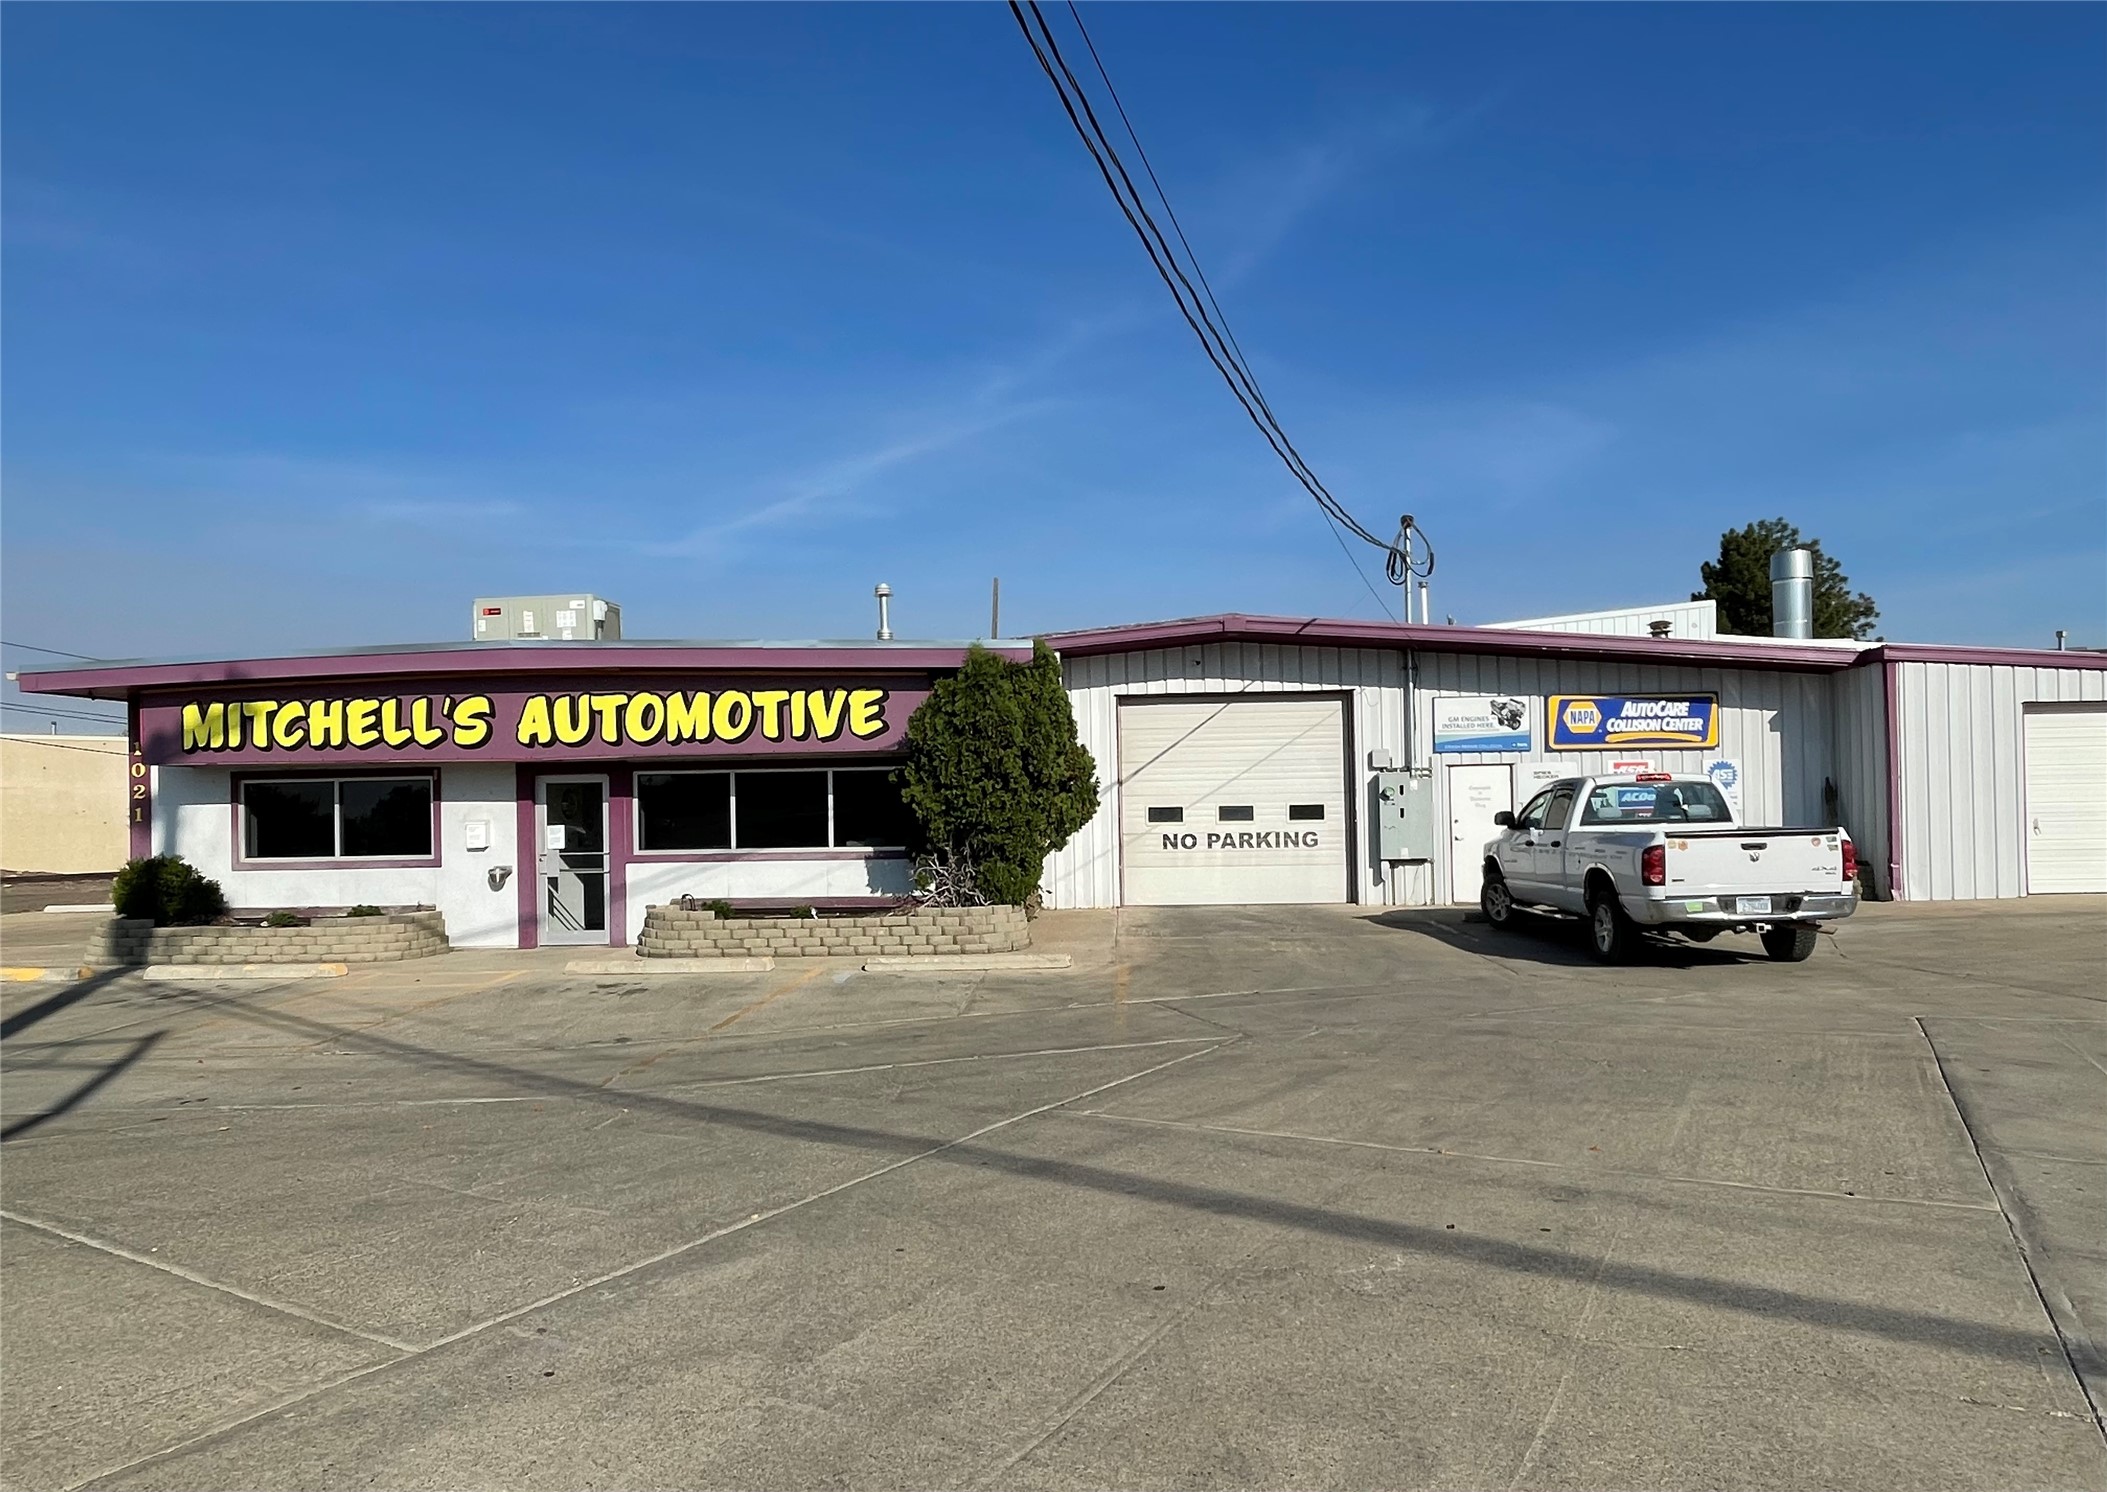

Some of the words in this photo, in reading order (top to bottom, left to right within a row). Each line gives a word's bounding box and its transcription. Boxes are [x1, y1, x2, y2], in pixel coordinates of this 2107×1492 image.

[181, 694, 495, 754] MITCHELL'S
[516, 685, 890, 748] AUTOMOTIVE
[1570, 710, 1595, 724] NAPA
[1661, 716, 1704, 731] CENTER
[130, 741, 146, 822] 1021
[1162, 833, 1197, 850] NO
[1207, 831, 1319, 850] PARKING
